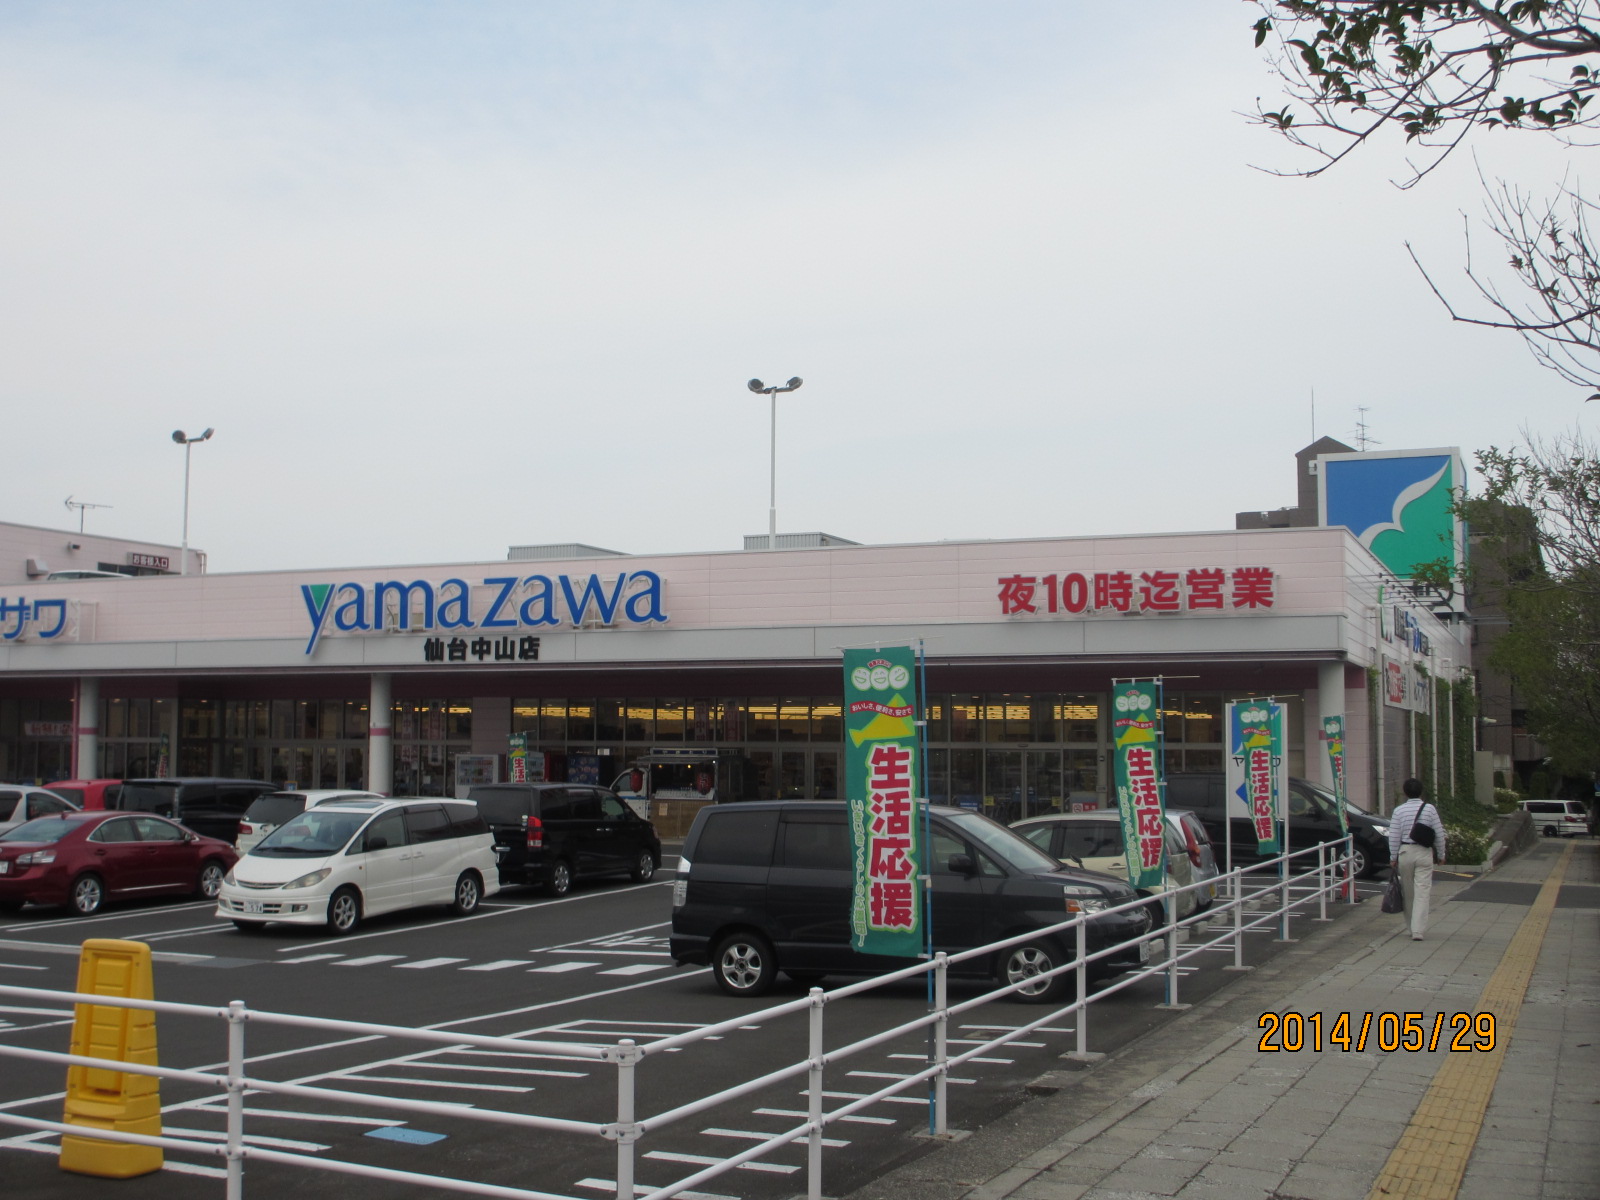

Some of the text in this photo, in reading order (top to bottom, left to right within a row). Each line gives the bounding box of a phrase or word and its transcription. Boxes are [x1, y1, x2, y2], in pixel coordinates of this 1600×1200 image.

[301, 570, 668, 655] yamazawa
[998, 567, 1276, 615] 夜10時迄営業
[424, 636, 541, 662] 仙台中山店
[869, 746, 913, 928] 生活応援
[1127, 748, 1163, 868] 生活応援
[1251, 749, 1273, 840] 生活応援
